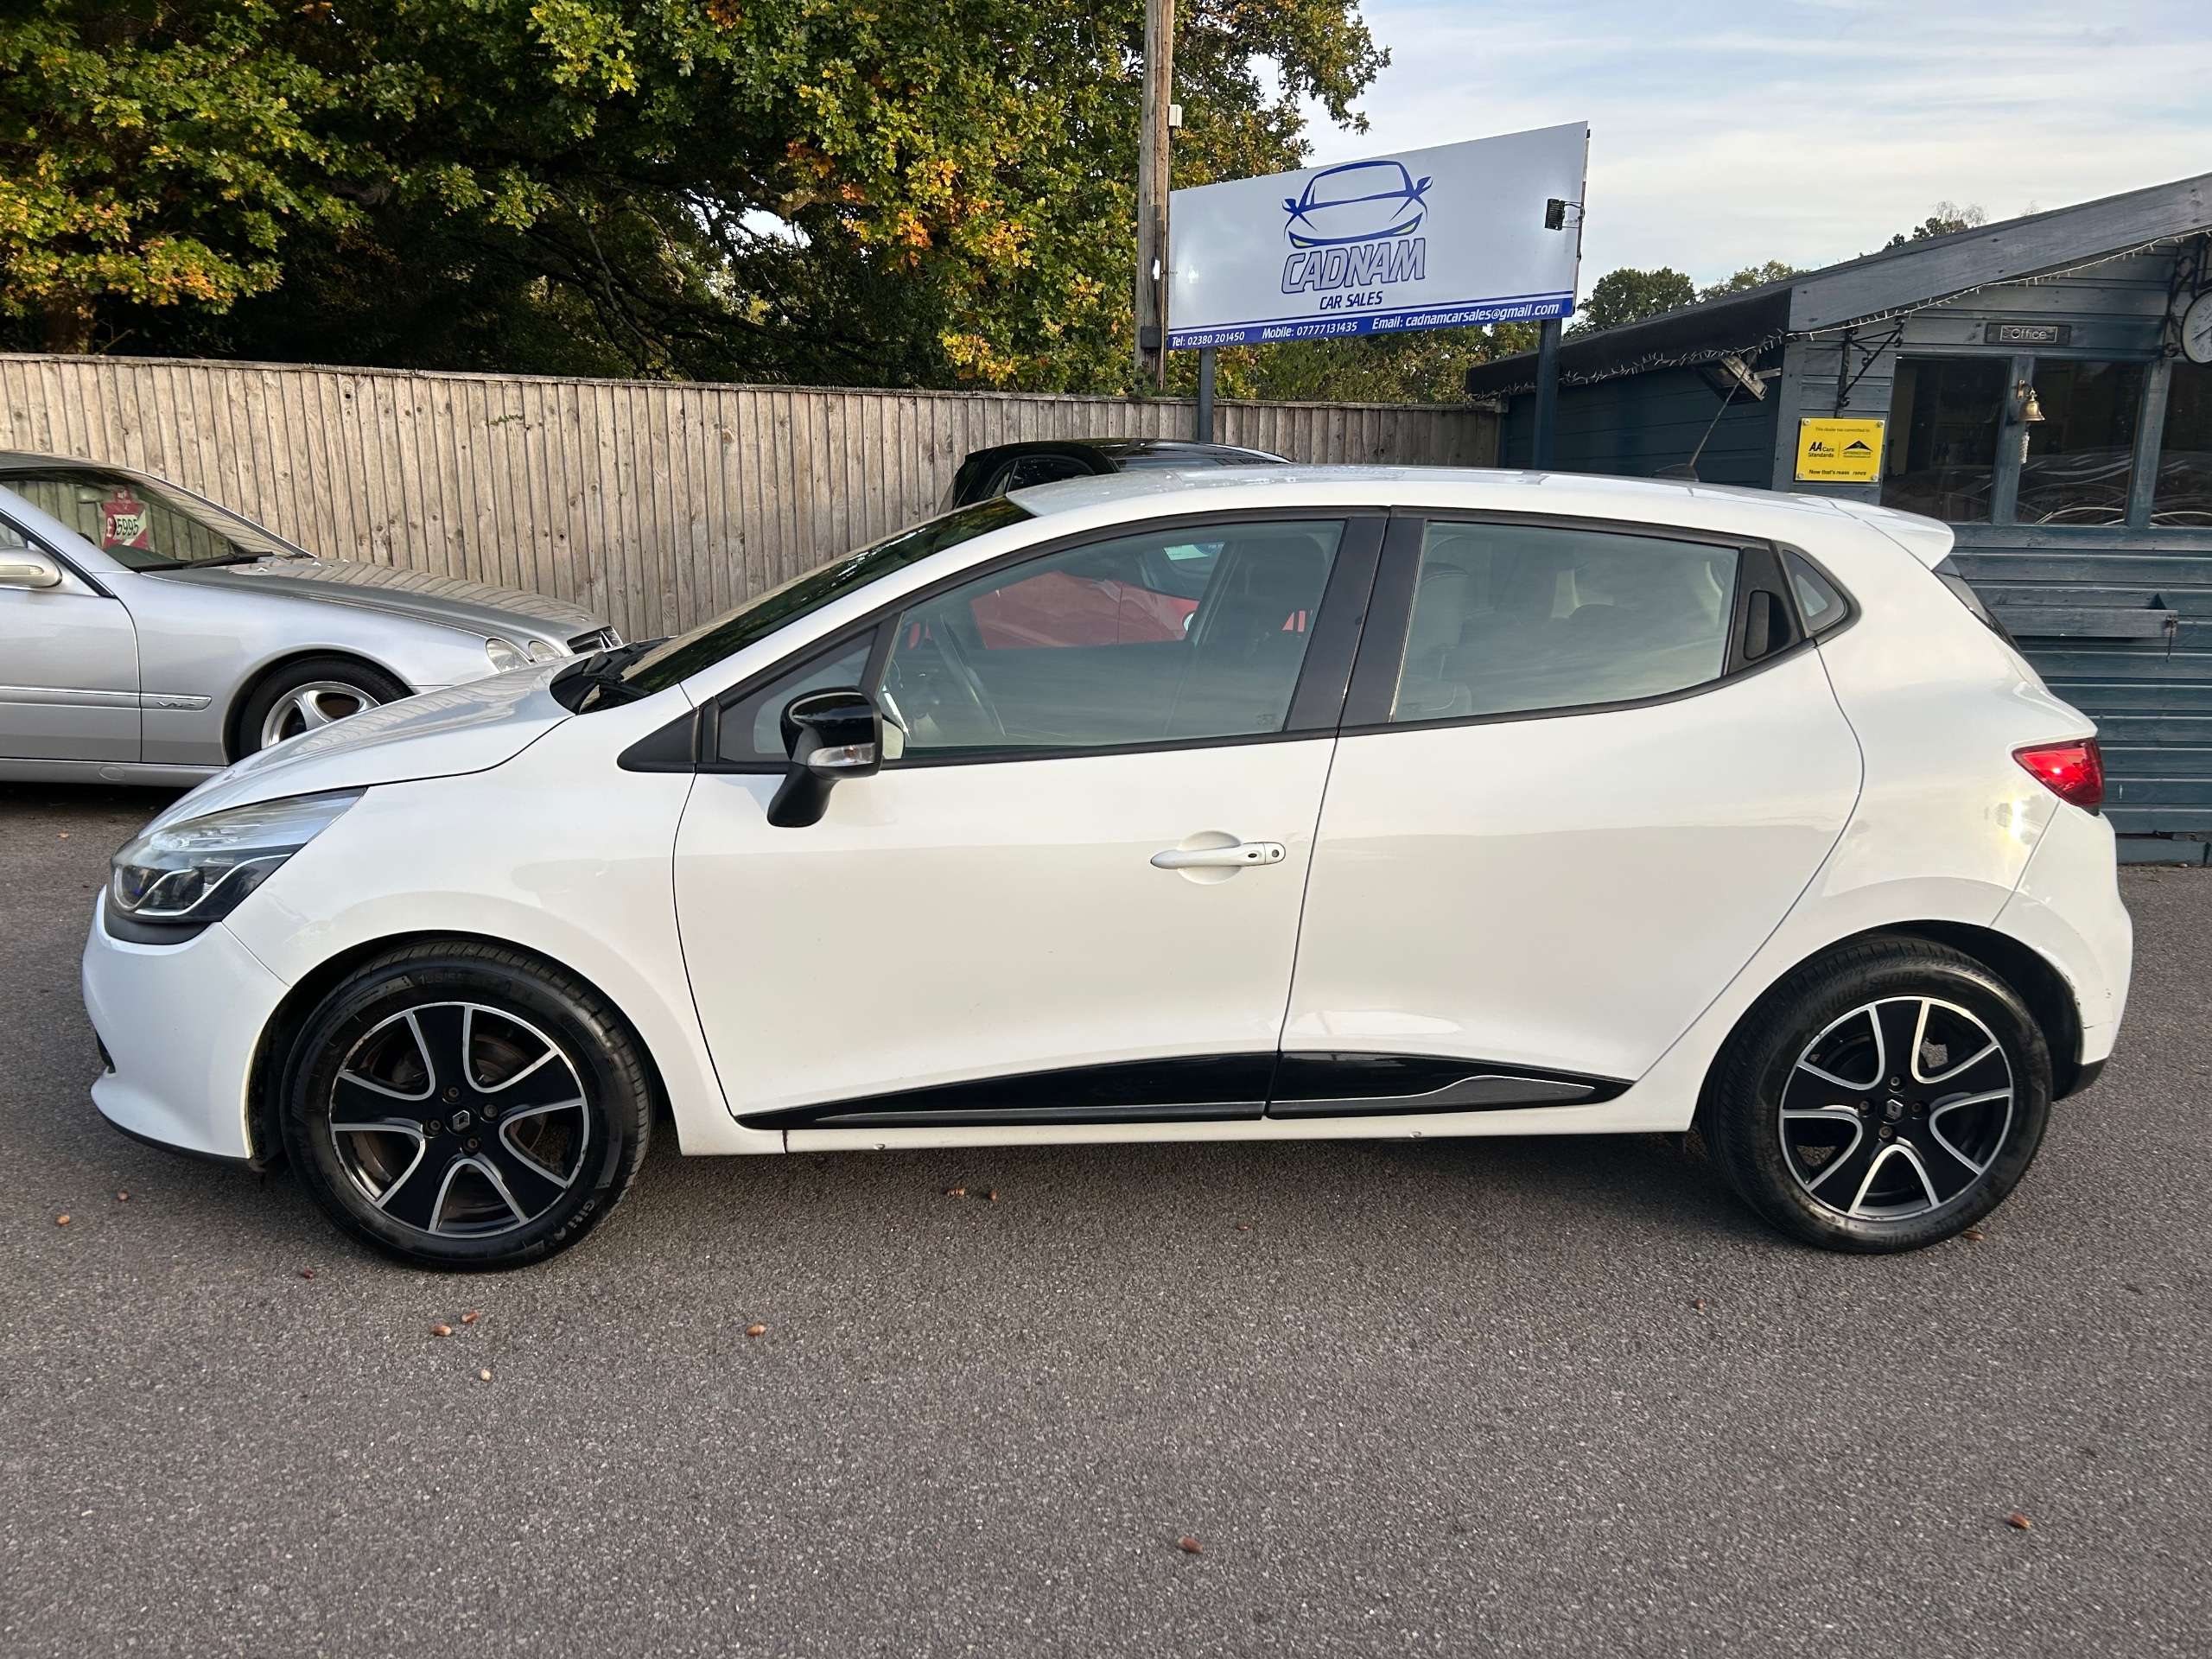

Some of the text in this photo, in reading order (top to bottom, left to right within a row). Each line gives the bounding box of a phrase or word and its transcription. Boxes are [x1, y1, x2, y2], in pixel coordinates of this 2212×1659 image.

[1281, 238, 1426, 294] CADNAM
[1319, 290, 1383, 310] CAR SALES
[1372, 303, 1560, 330] Email: cadnamcarsales@gmail.com
[1172, 331, 1245, 346] Tel: 02380 201450
[1262, 321, 1358, 339] Mobile: 07777131435
[2011, 327, 2047, 340] Office
[1808, 442, 1822, 452] AA
